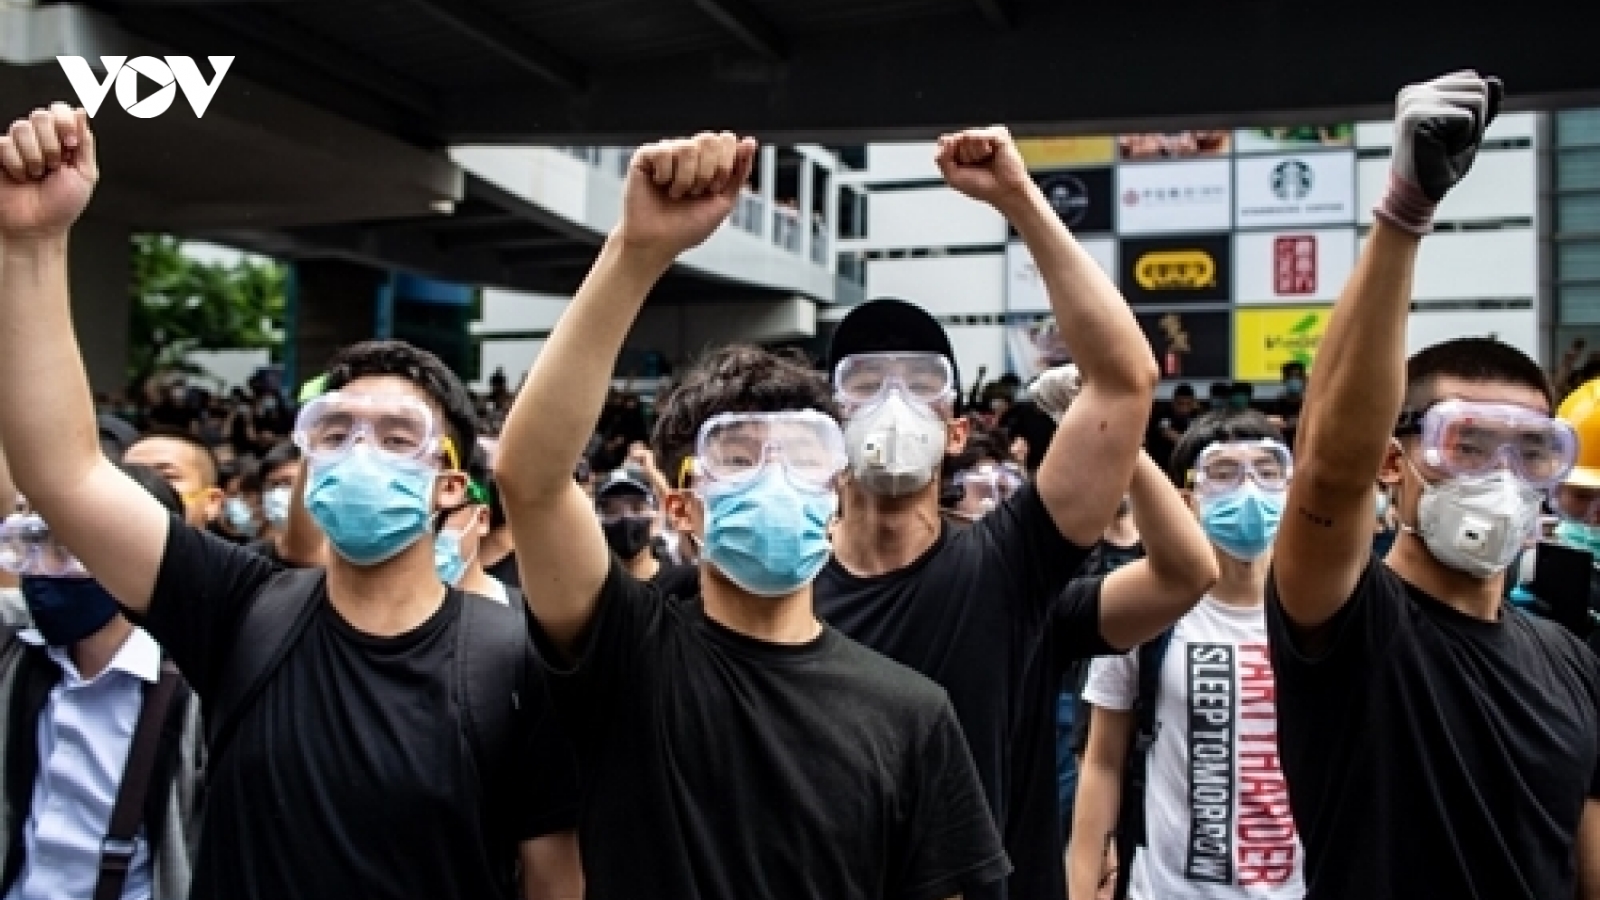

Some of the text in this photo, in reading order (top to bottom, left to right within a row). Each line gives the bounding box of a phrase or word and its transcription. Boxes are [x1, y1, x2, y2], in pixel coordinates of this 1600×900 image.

[1190, 646, 1230, 880] SLEEP TOMORROW
[1237, 753, 1297, 886] HARDER
